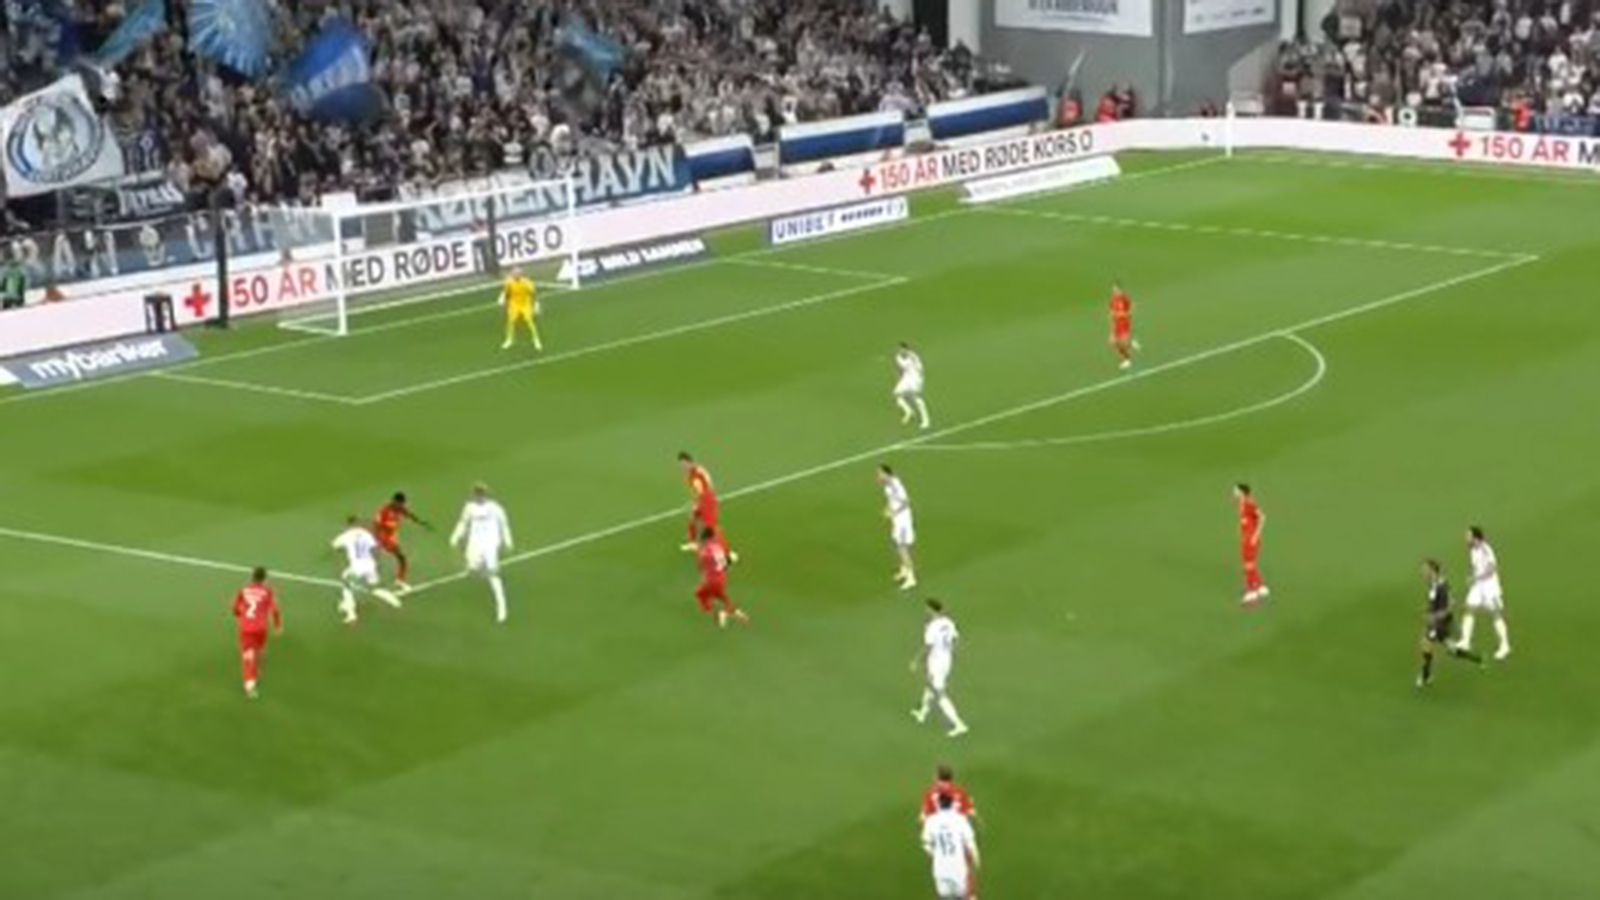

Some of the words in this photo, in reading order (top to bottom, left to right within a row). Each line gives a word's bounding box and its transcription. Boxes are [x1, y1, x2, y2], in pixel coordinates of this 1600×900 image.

[880, 161, 910, 188] 150
[914, 157, 939, 181] ÅR
[942, 149, 981, 176] MED
[984, 140, 1030, 169] RØDE
[1033, 132, 1077, 161] KORS
[1481, 136, 1524, 159] 150
[775, 211, 836, 239] UNIBET
[233, 274, 269, 307] 50
[278, 265, 317, 299] ÅR
[325, 255, 385, 291] MED
[394, 240, 468, 281] RØDE
[495, 227, 539, 260] ORS
